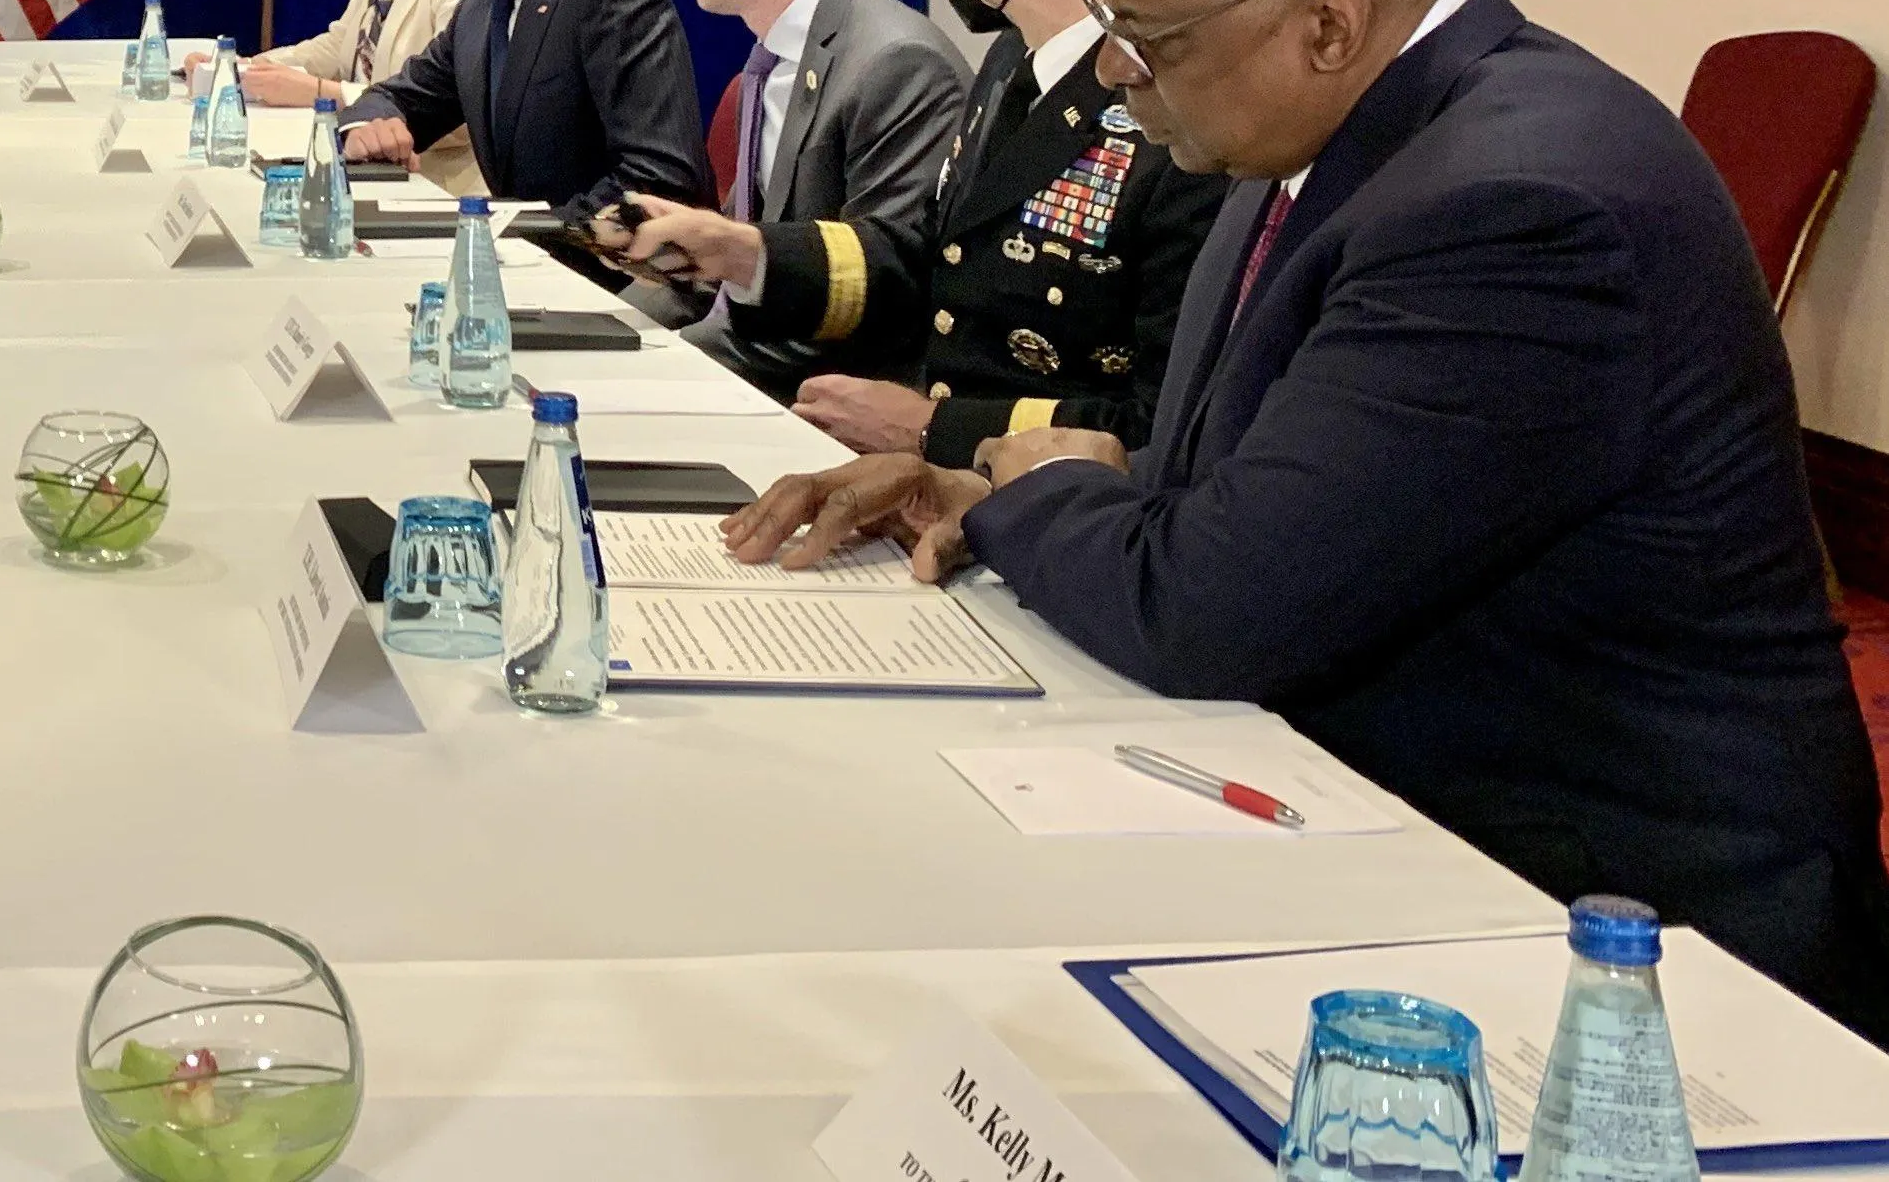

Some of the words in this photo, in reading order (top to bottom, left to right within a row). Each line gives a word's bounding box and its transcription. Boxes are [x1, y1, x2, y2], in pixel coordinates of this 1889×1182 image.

[942, 1066, 979, 1124] Ms.
[977, 1103, 1035, 1181] Kelly
[900, 1150, 920, 1177] TO
